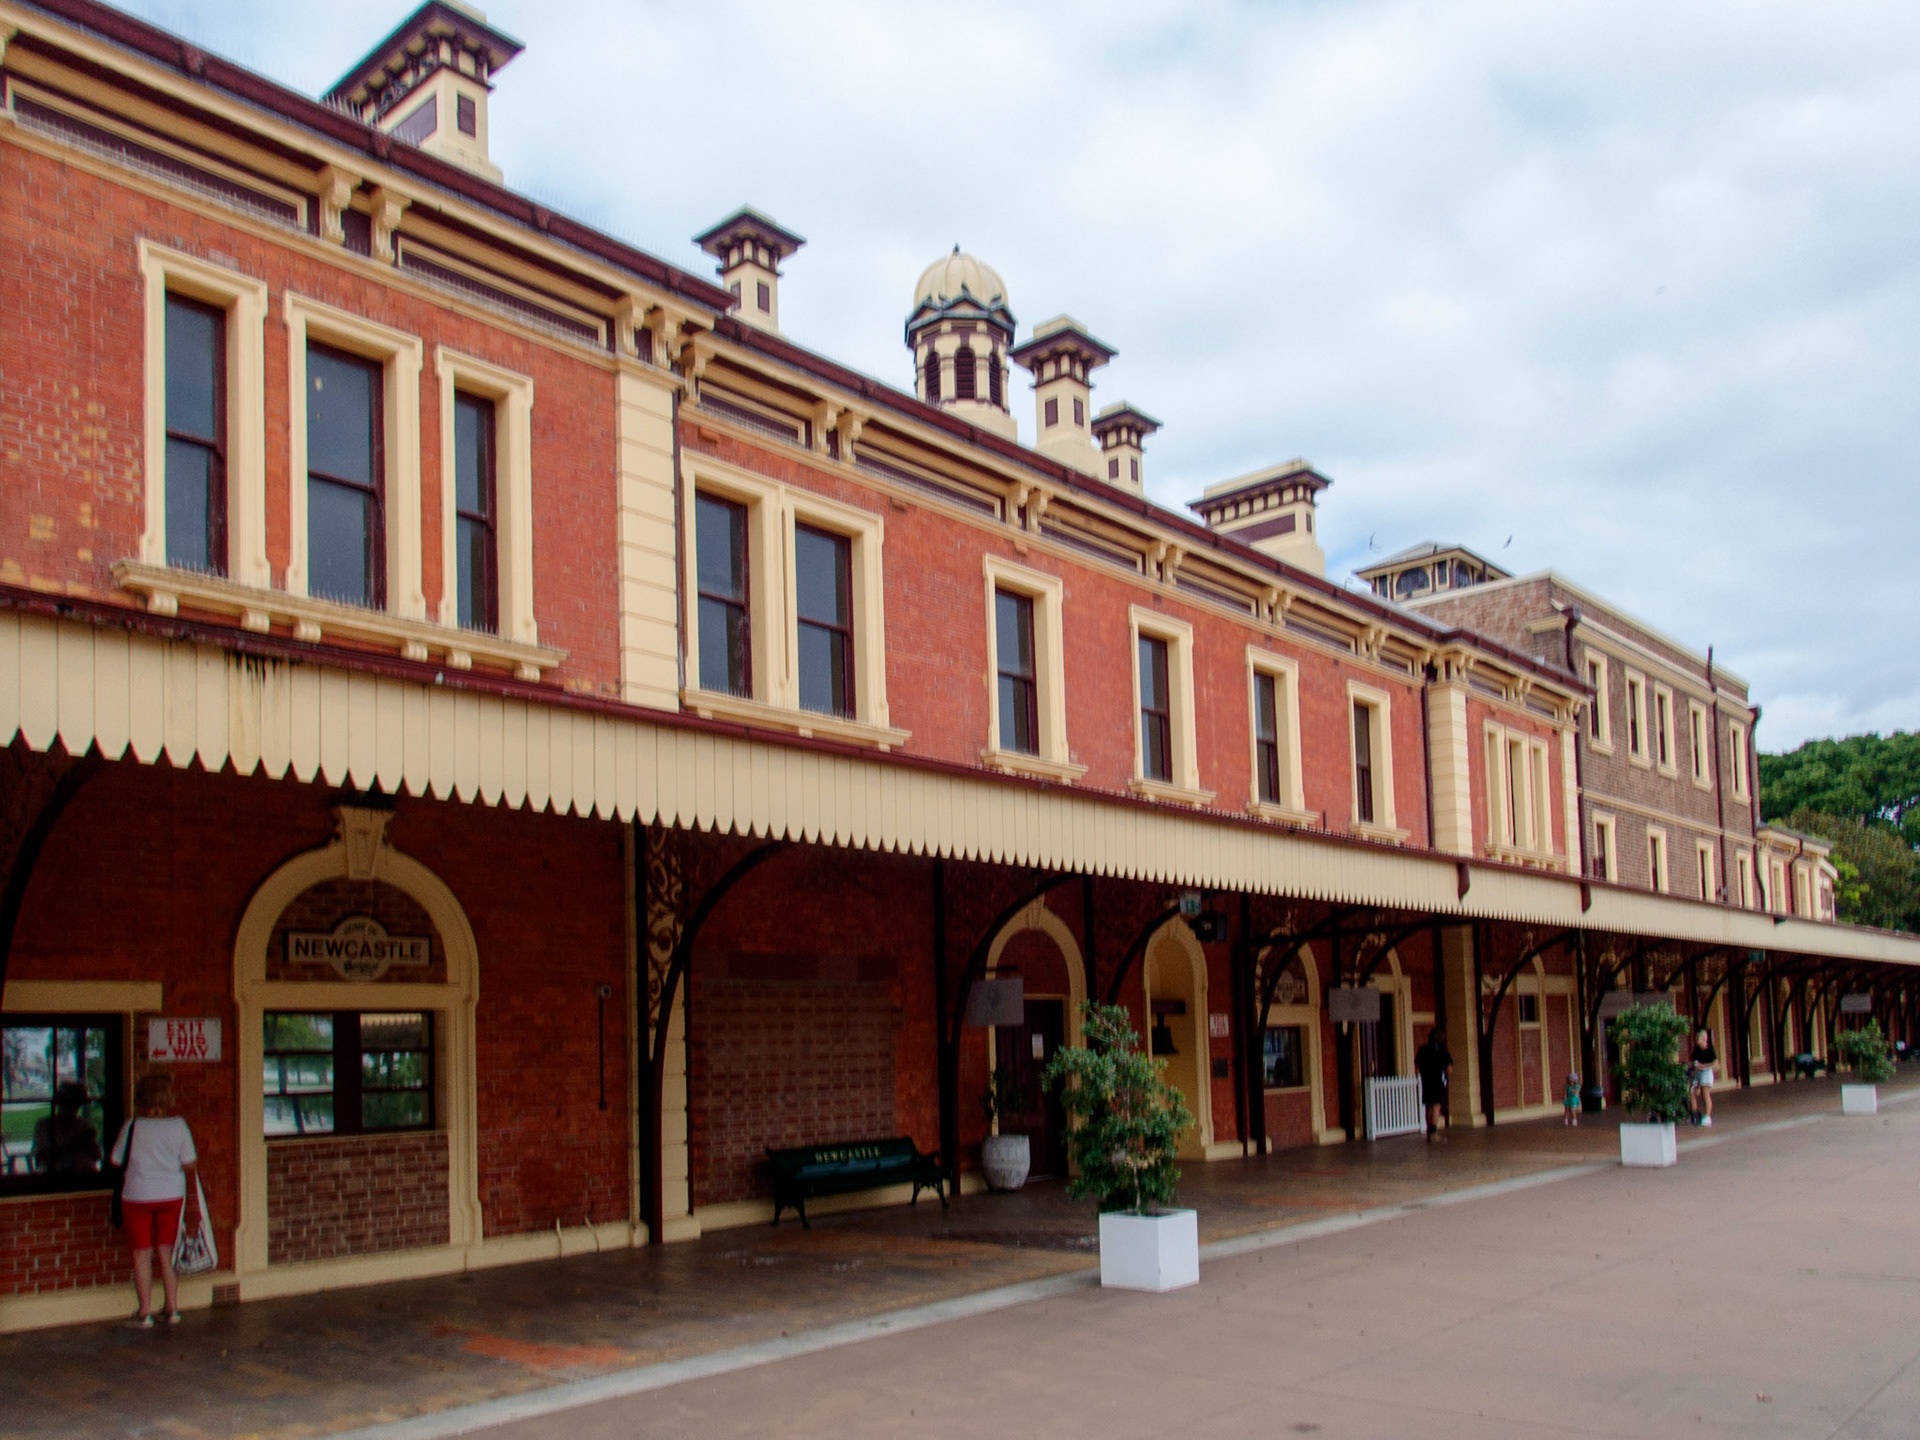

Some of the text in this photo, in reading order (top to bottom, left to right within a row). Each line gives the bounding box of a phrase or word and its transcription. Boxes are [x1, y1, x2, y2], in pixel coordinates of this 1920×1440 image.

[294, 938, 422, 961] NEWCASTLE
[166, 1018, 206, 1033] EXIT
[166, 1032, 206, 1047] THIS
[172, 1045, 209, 1060] WAY
[815, 1146, 880, 1163] NEWCASTLE
